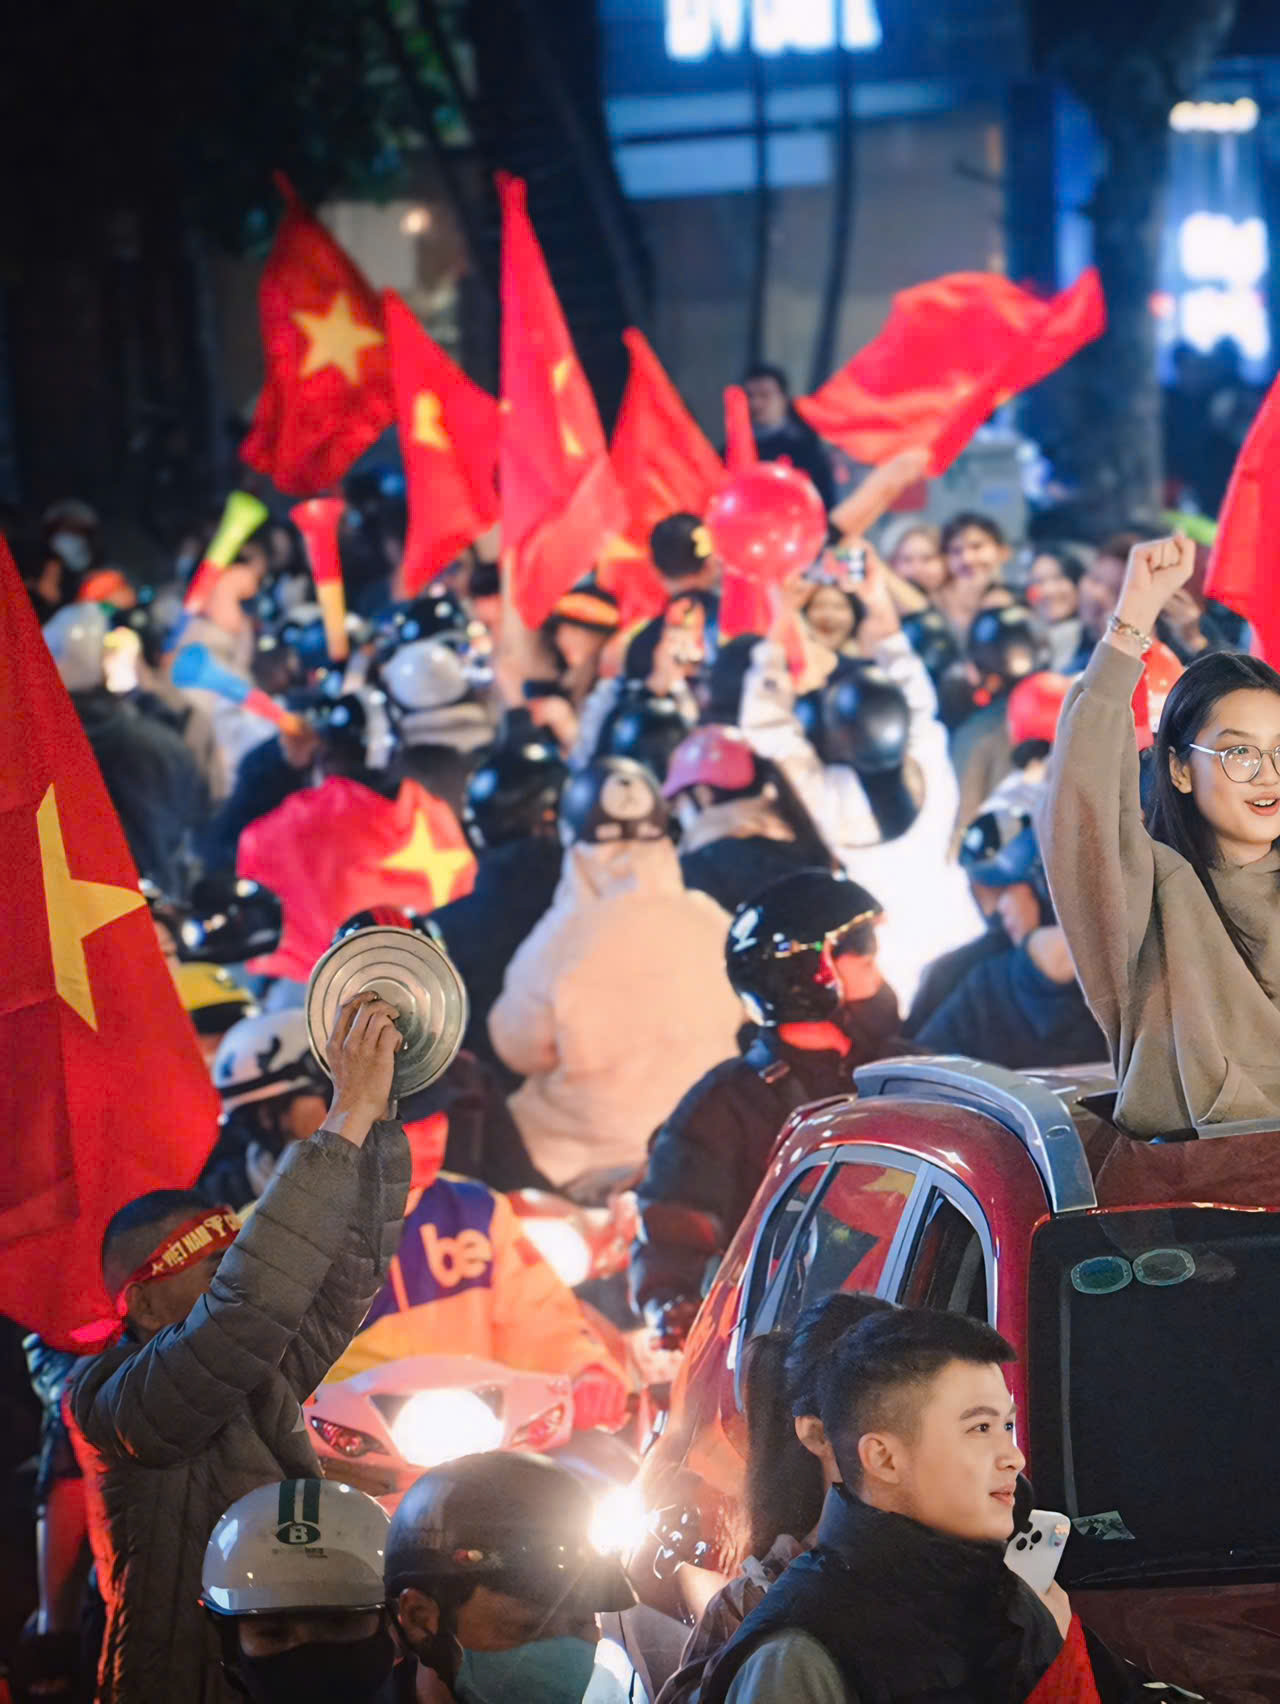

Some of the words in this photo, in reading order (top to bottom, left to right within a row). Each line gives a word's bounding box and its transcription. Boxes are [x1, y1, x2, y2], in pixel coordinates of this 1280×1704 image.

[181, 1225, 213, 1254] NAM
[419, 1222, 491, 1288] be
[289, 1525, 309, 1543] B
